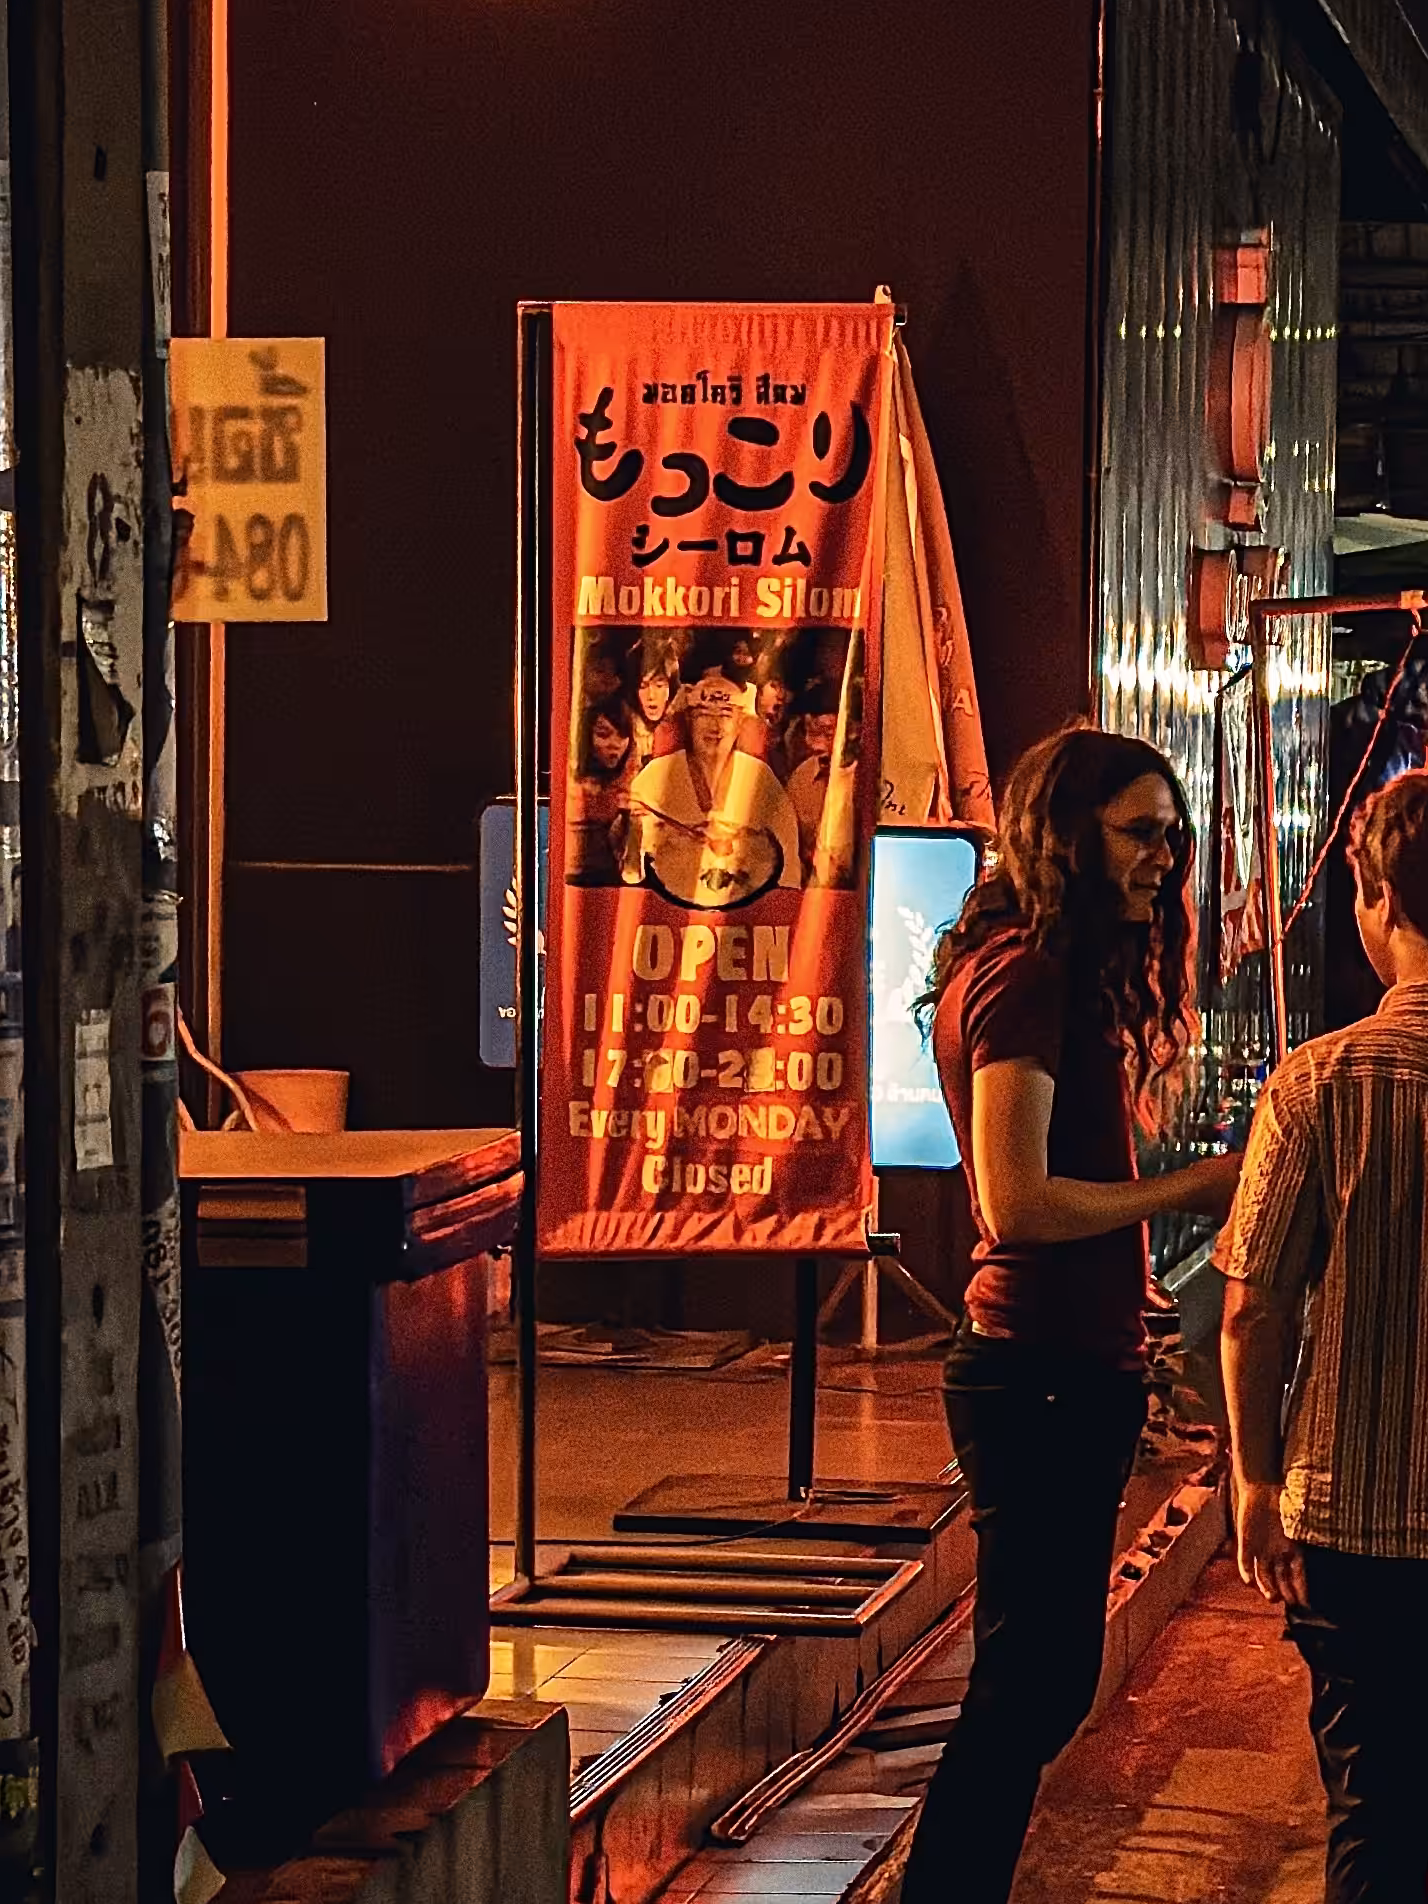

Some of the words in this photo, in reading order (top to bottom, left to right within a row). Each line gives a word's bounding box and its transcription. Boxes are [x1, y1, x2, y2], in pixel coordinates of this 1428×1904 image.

[574, 387, 872, 517] もっこり
[631, 524, 812, 568] シーロム
[578, 575, 740, 617] Mokkori
[756, 577, 861, 618] Silom
[632, 924, 789, 982] OPEN
[584, 993, 844, 1035] 11:00-14:30
[569, 1101, 665, 1149] Every
[673, 1104, 851, 1142] MONDAY
[642, 1154, 773, 1195] Closed
